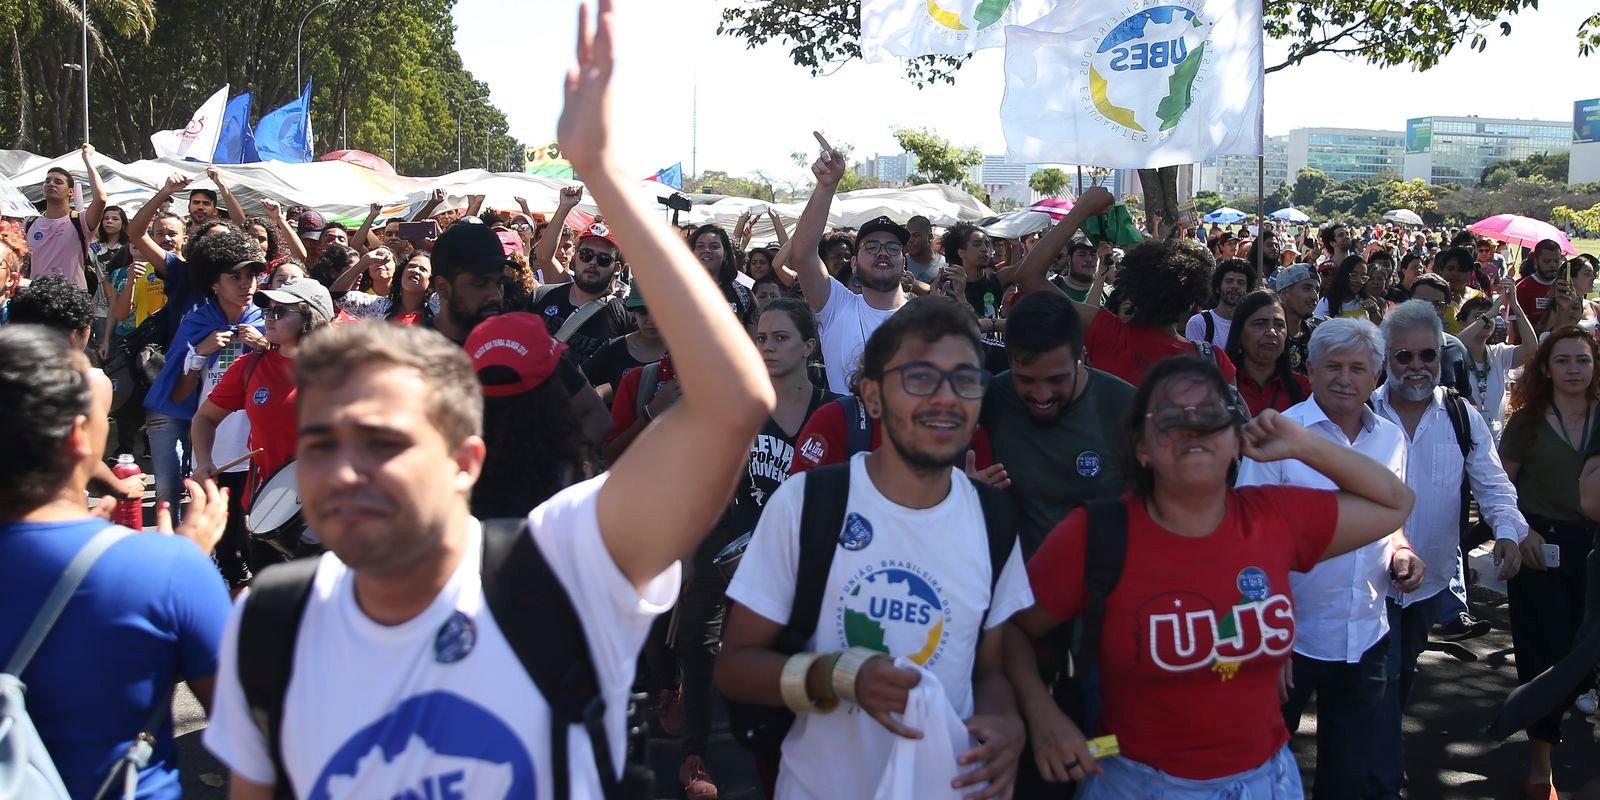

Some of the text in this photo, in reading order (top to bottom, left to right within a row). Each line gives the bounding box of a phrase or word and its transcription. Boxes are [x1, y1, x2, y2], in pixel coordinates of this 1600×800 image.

[751, 461, 790, 482] JUVEN
[843, 564, 873, 593] UNIÃO
[880, 560, 942, 593] BRASILEIRA
[942, 599, 952, 623] DOS
[869, 596, 931, 625] UBES
[1150, 594, 1295, 671] UJS
